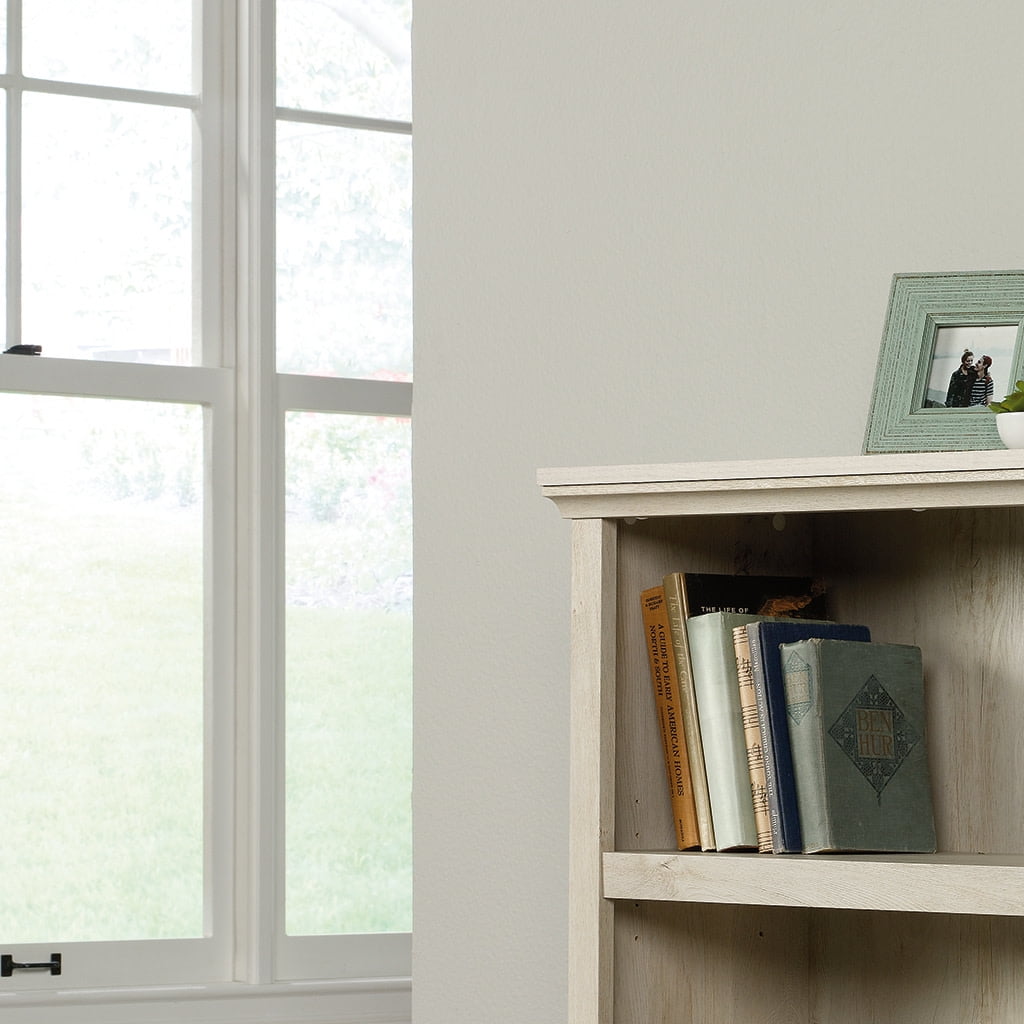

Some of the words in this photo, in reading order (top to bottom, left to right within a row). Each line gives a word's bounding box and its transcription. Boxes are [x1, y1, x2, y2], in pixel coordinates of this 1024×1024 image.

[659, 631, 668, 659] GUIDE
[650, 625, 659, 656] NORTH
[655, 666, 663, 696] SOUTH
[662, 661, 669, 673] TO
[664, 675, 672, 701] EARLY
[667, 705, 680, 757] AMERICAN
[858, 710, 892, 732] BEN
[859, 735, 893, 756] HUR
[673, 761, 684, 796] HOMES
